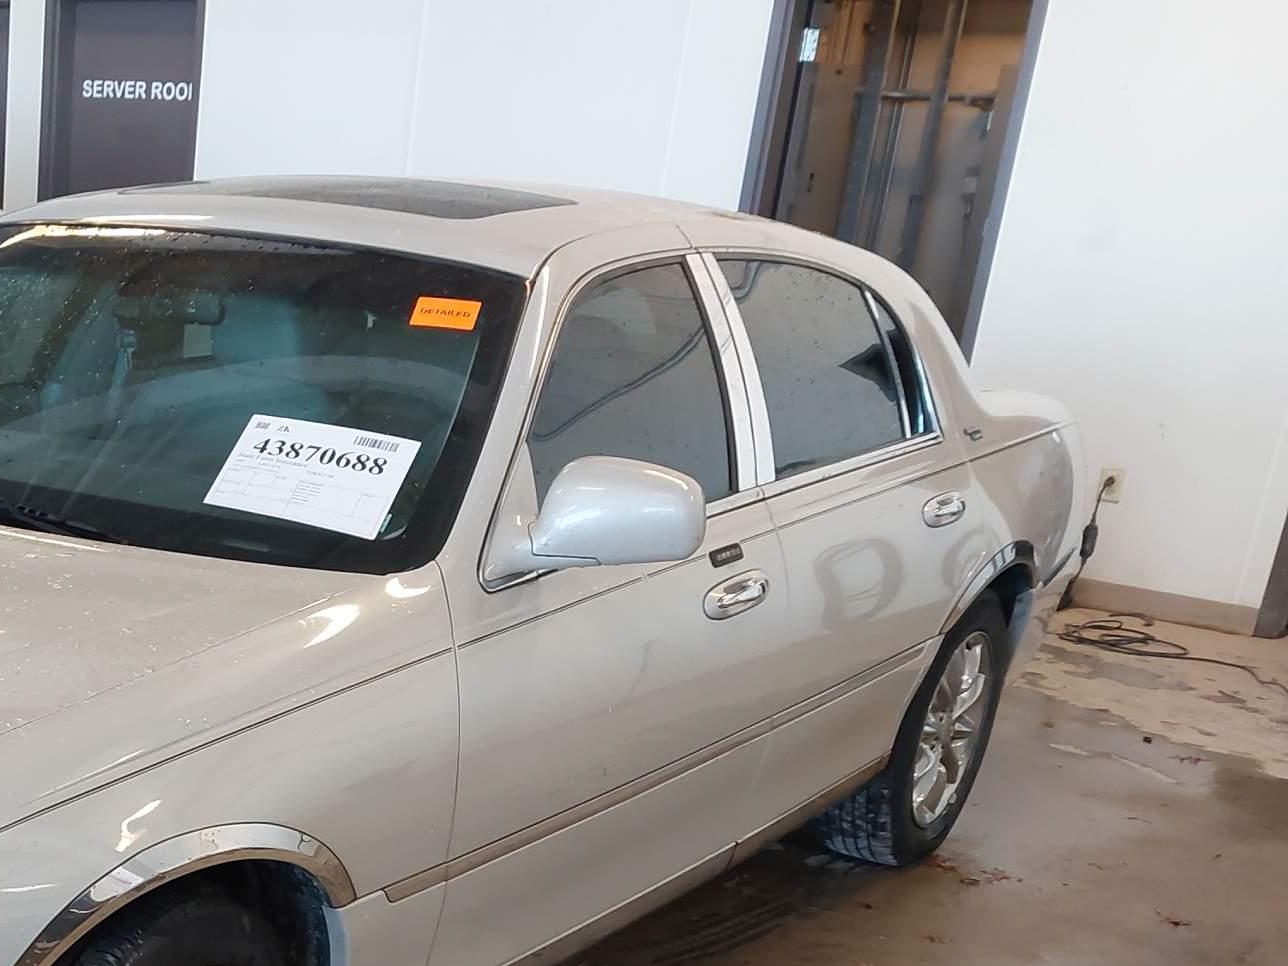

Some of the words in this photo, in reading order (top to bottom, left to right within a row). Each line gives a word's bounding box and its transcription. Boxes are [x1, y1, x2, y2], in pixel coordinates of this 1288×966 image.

[82, 79, 147, 99] SERVER
[150, 81, 193, 101] ROO
[252, 438, 388, 476] 43870688
